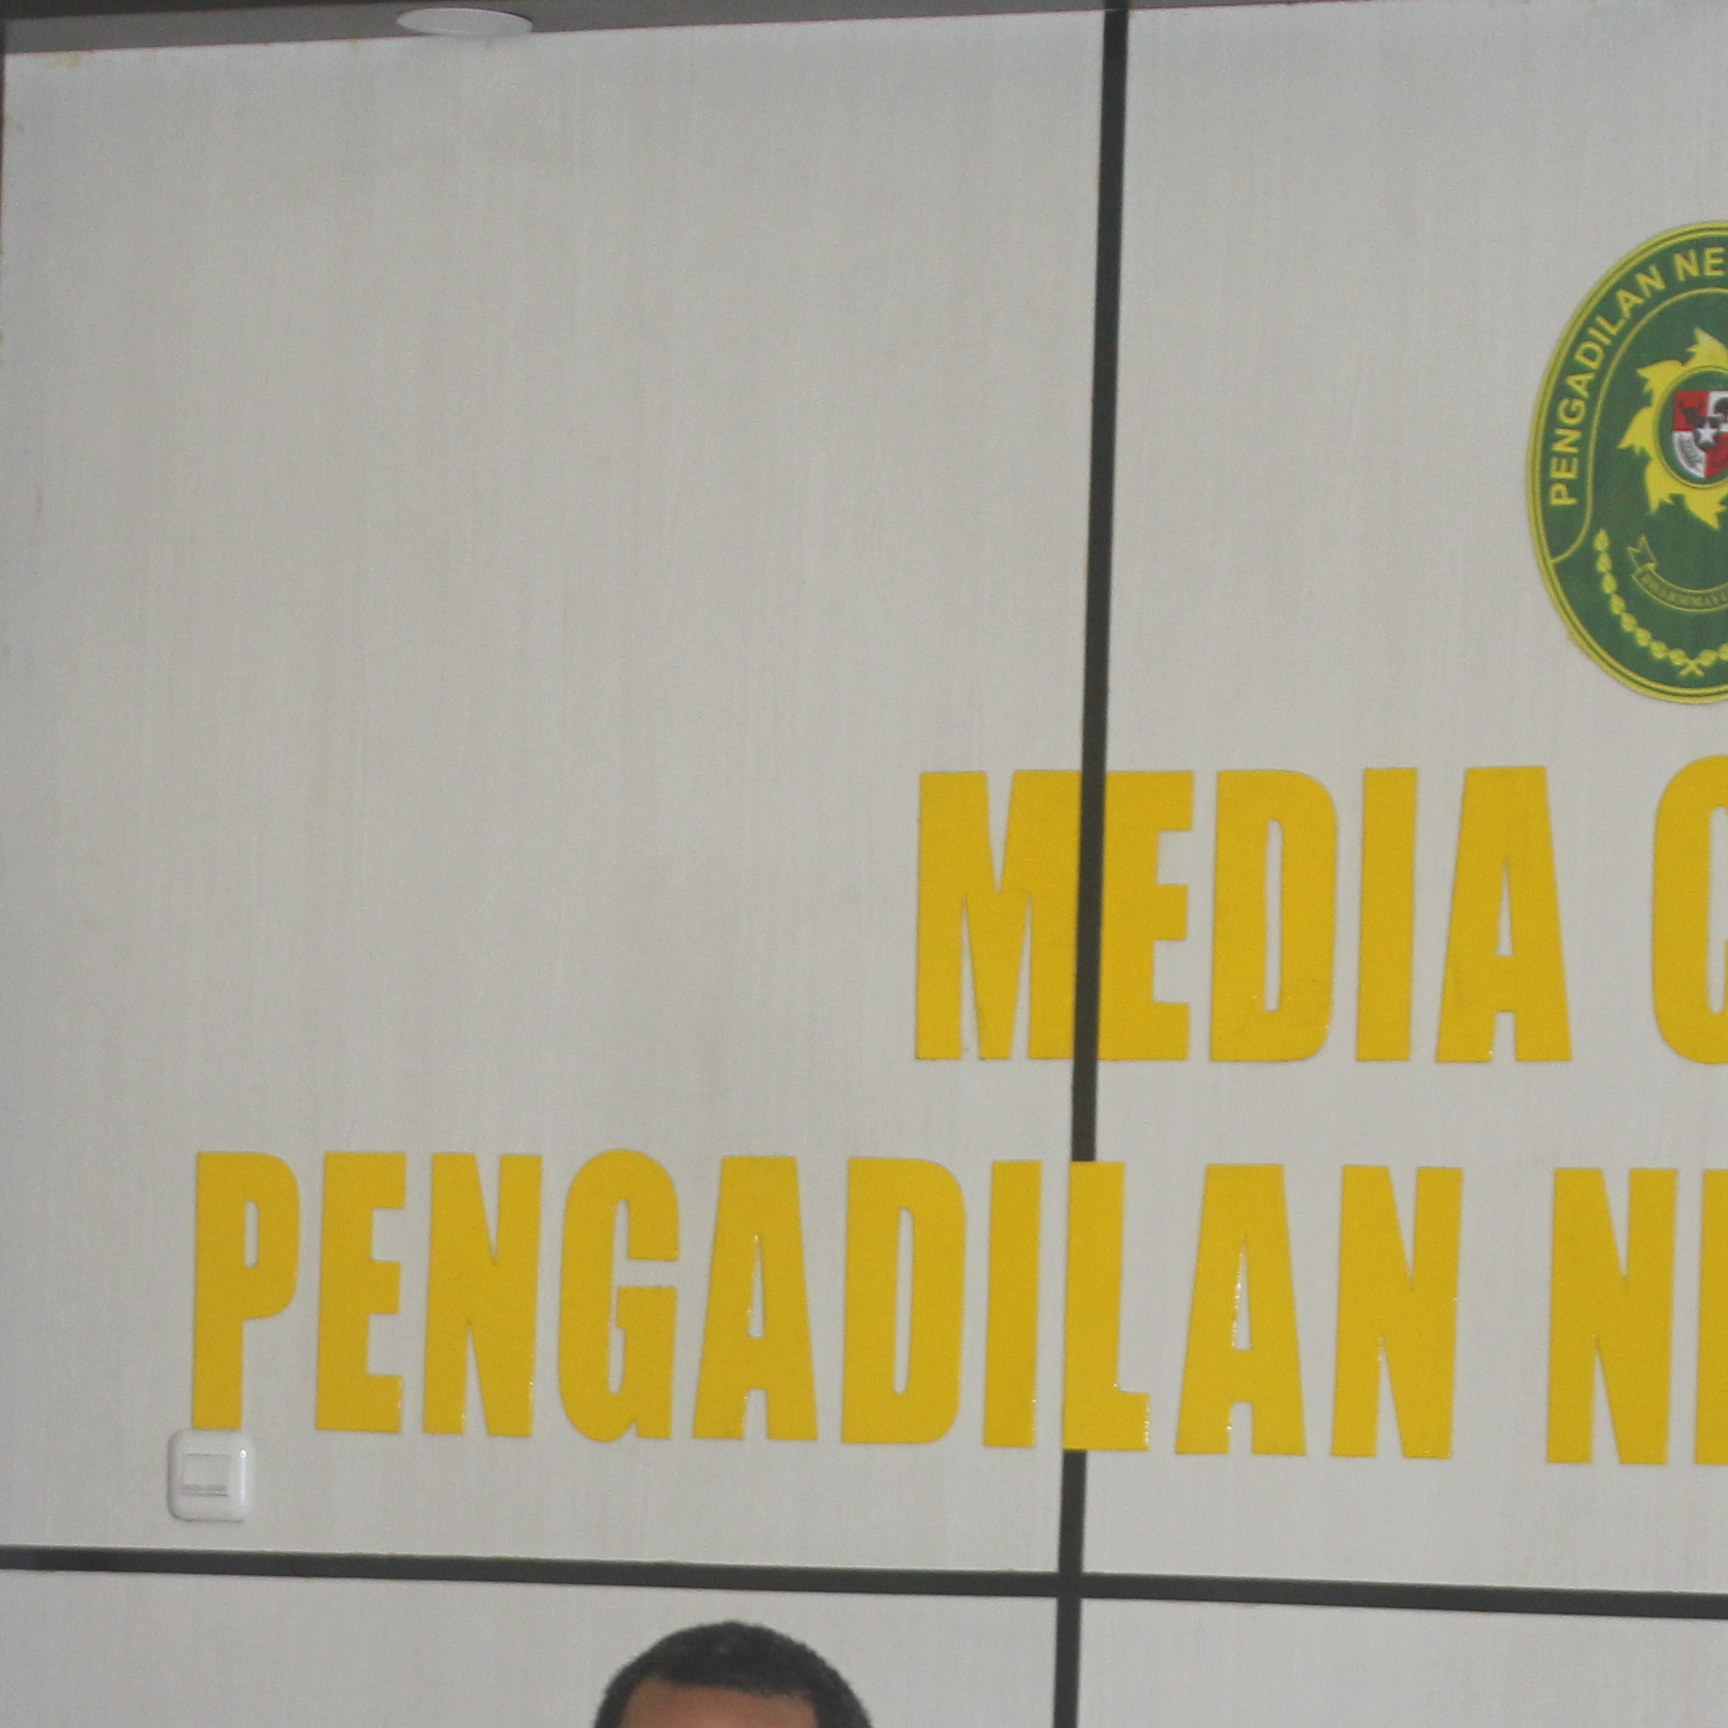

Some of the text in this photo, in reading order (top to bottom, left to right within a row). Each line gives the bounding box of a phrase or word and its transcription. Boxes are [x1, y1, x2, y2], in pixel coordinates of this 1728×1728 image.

[1550, 266, 1665, 506] PENGADILAN
[915, 765, 1573, 1063] MEDIA
[191, 1149, 1464, 1460] PENGADILAN
